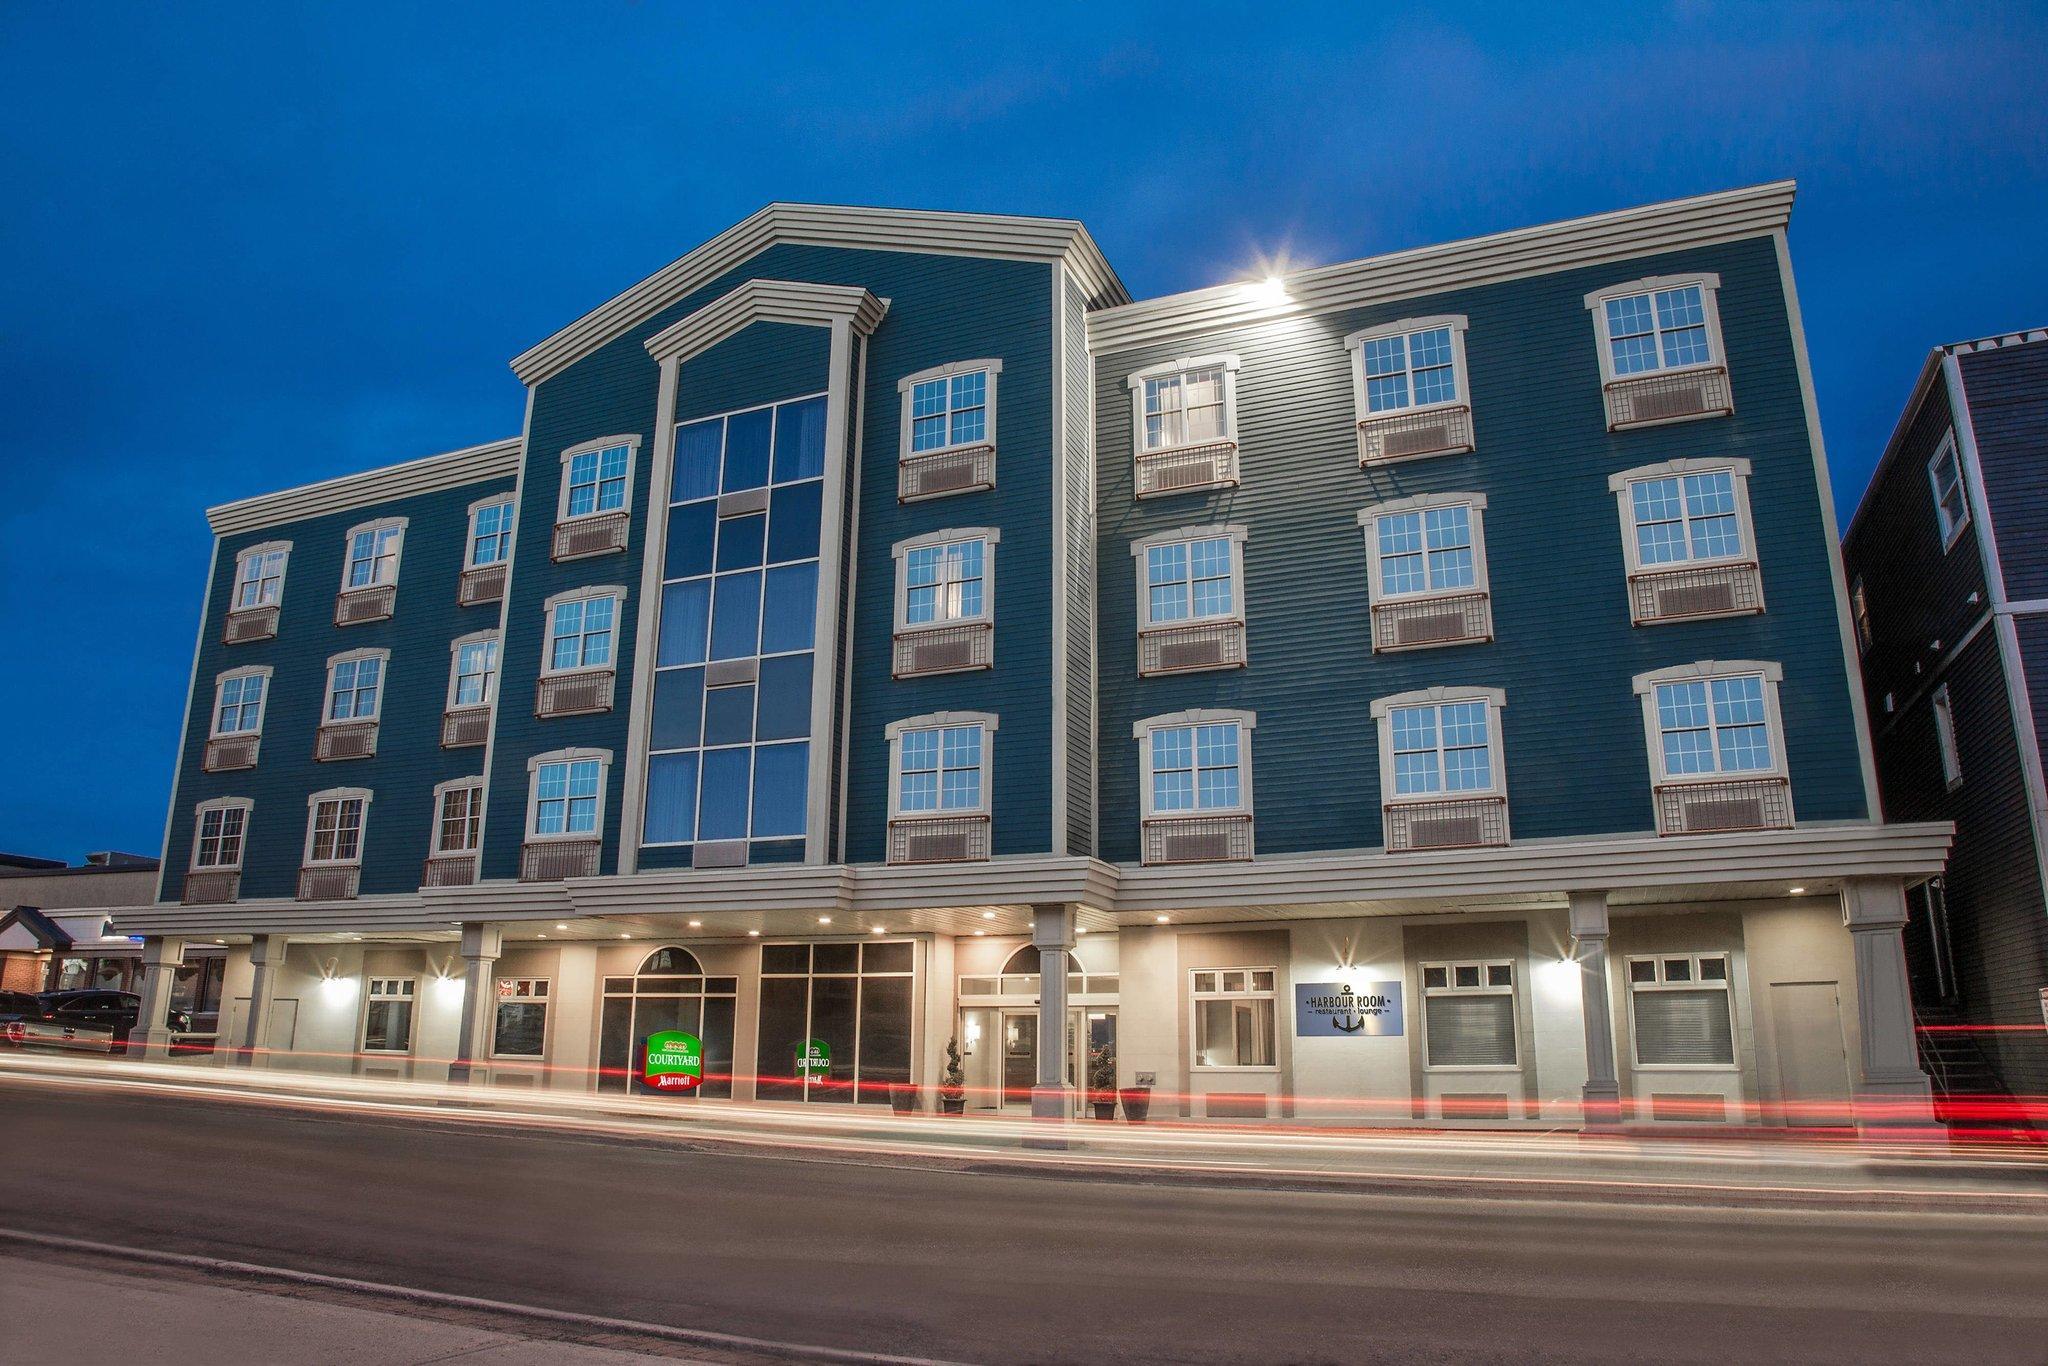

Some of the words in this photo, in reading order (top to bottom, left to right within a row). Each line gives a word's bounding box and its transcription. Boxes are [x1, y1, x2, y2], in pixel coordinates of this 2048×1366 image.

[1311, 996, 1354, 1007] HARBOUR
[1357, 995, 1385, 1007] ROOM
[1357, 1008, 1382, 1016] lounge
[648, 1053, 700, 1066] COURTYARD
[657, 1075, 690, 1086] Marriott
